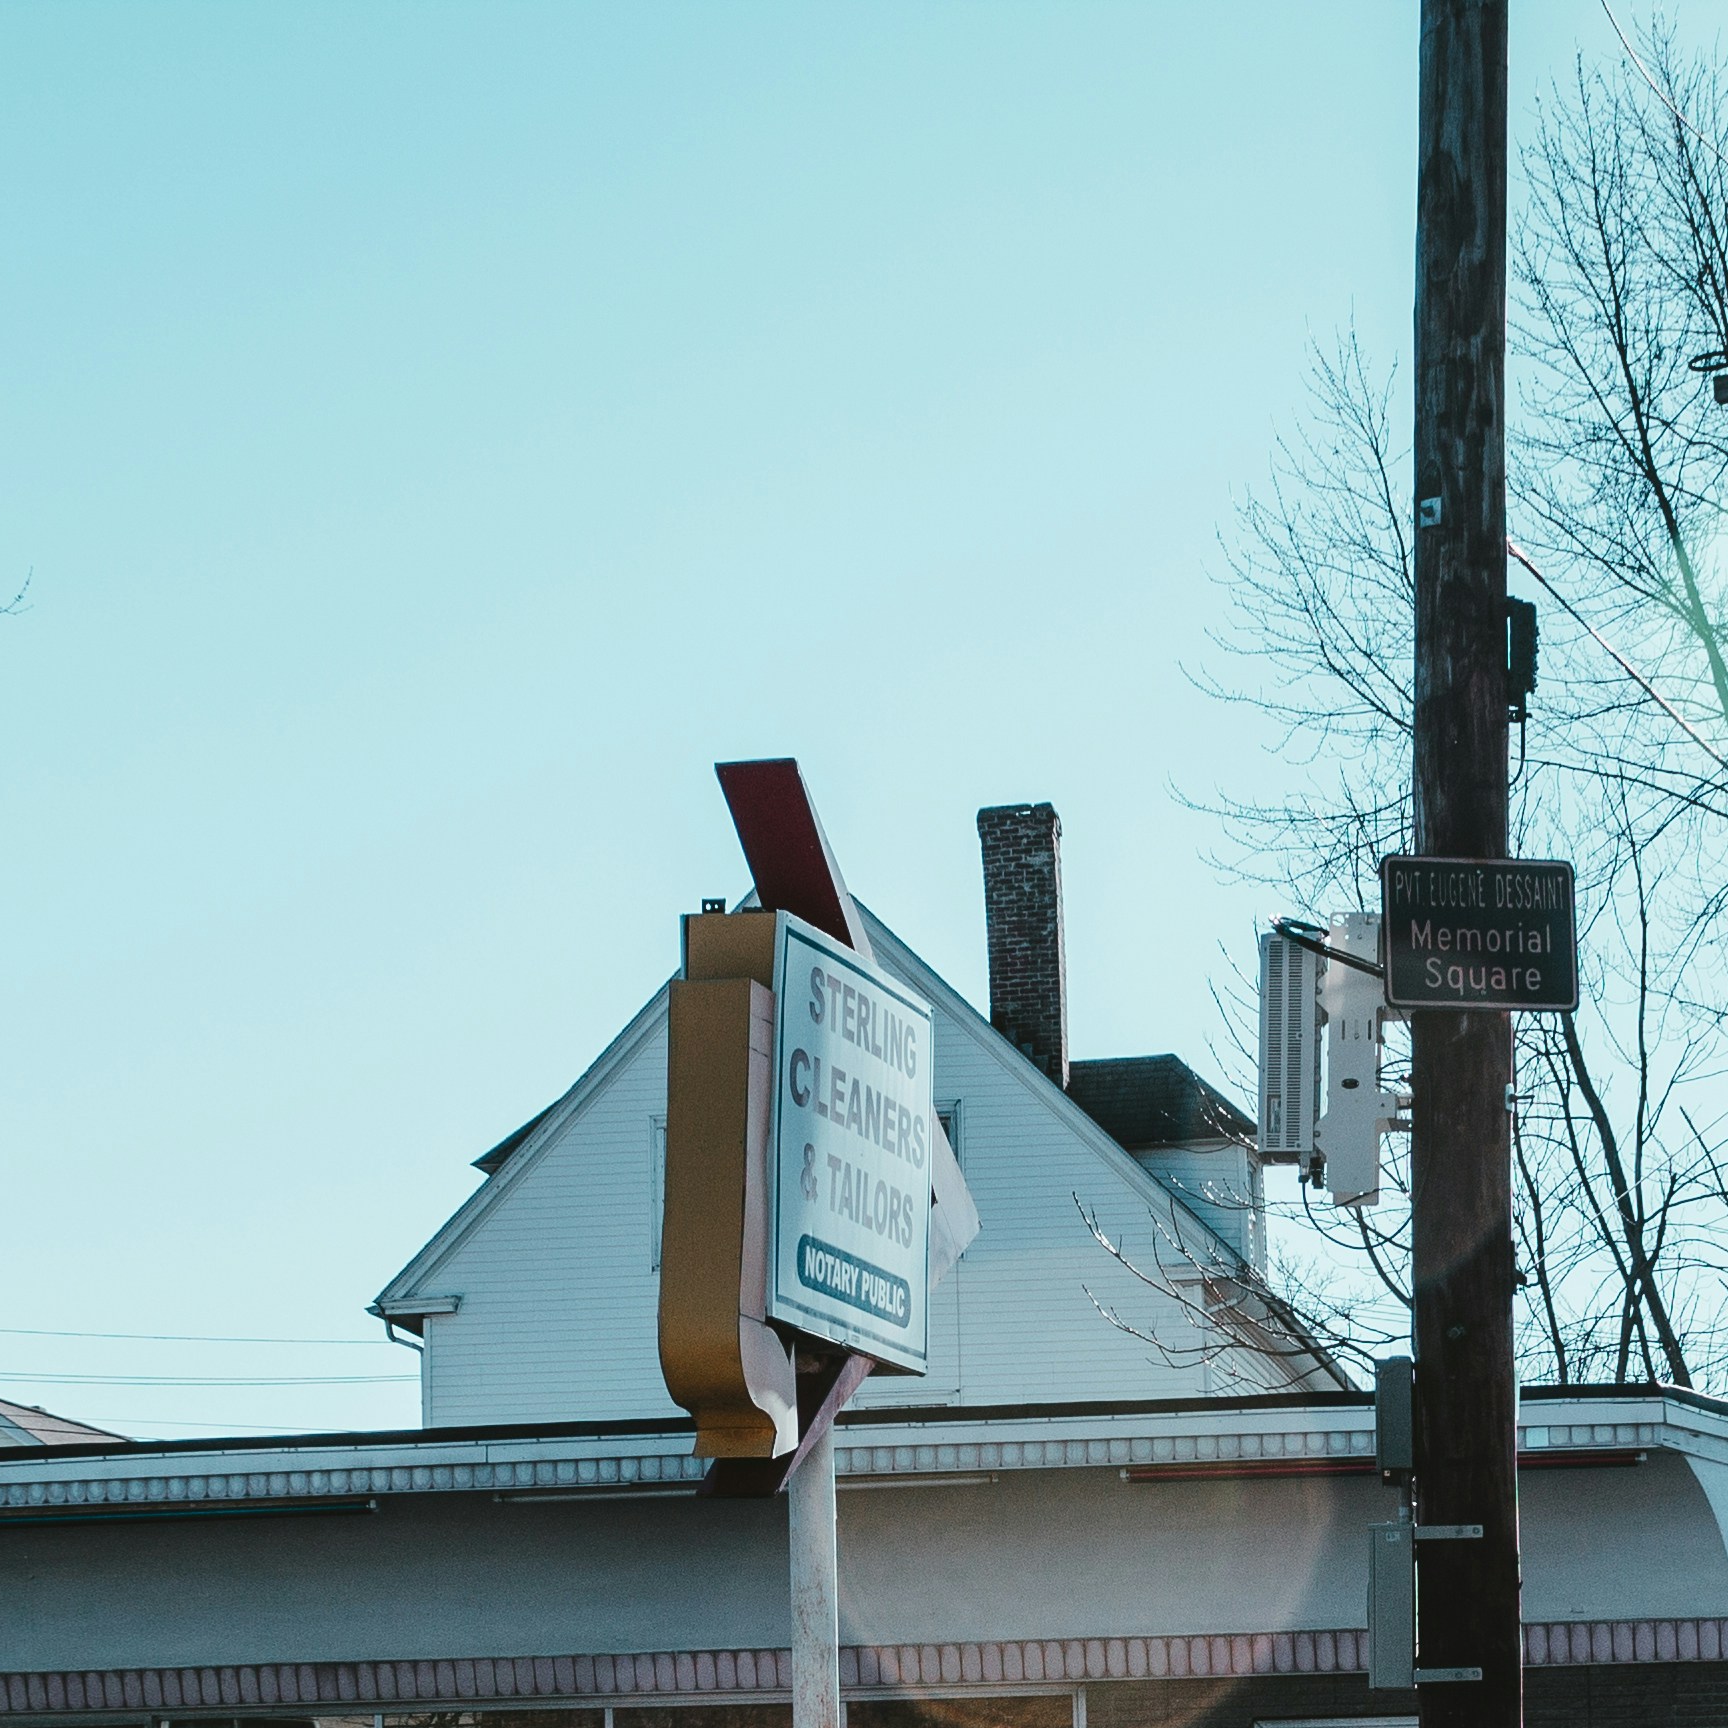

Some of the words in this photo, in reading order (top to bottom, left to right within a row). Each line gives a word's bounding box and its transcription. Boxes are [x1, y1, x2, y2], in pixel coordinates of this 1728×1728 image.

[1430, 871, 1486, 908] EUGENE
[1495, 873, 1564, 910] DESSAINT
[1411, 919, 1551, 953] Memorial
[1425, 957, 1542, 995] Square
[809, 966, 916, 1079] STERLING
[789, 1048, 925, 1170] CLEANERS
[800, 1143, 818, 1203] &
[827, 1152, 914, 1249] TAILORS
[805, 1245, 859, 1297] NOTARY
[861, 1270, 905, 1318] PUBLIC
